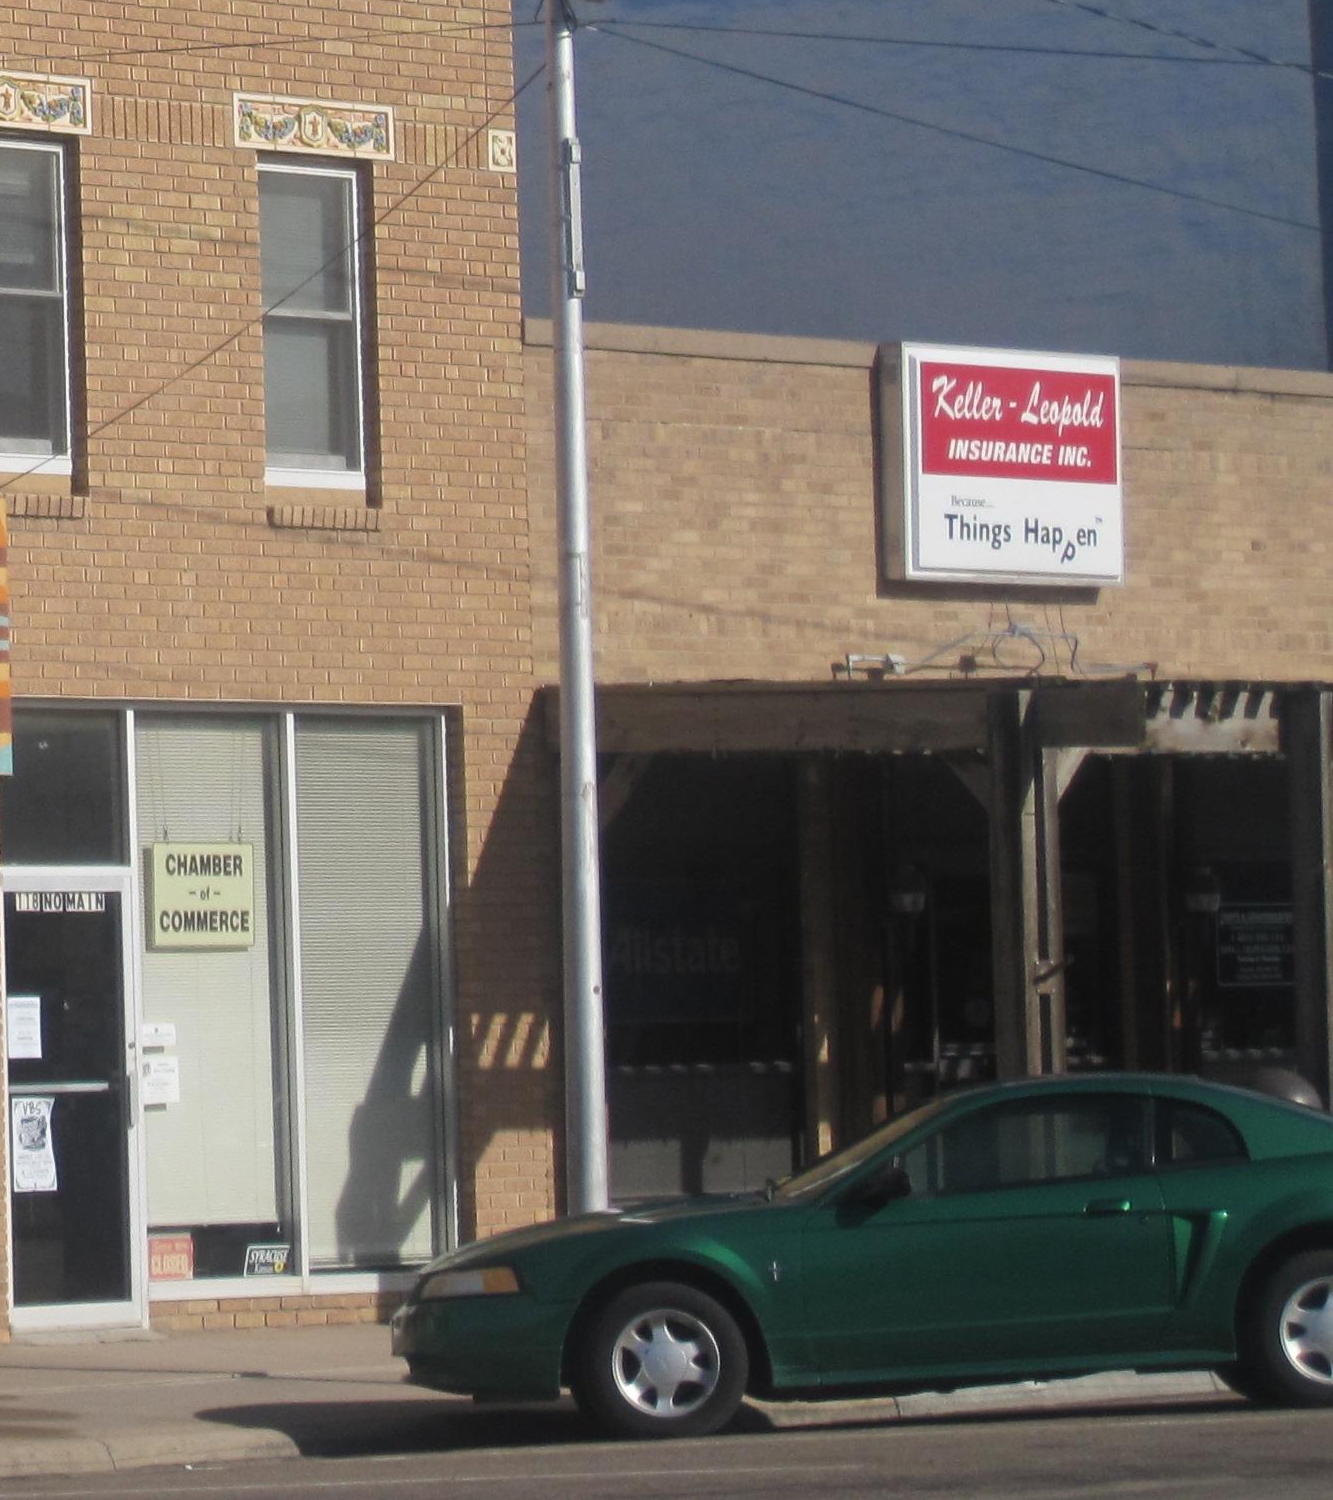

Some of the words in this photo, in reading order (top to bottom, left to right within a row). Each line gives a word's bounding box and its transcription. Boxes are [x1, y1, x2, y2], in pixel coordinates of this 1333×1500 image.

[932, 374, 1003, 421] Keller
[1021, 380, 1104, 437] Leopold
[948, 438, 1053, 465] INSURANCE
[1058, 445, 1092, 468] INC.
[951, 494, 995, 509] Because...
[944, 513, 1012, 550] Things
[1024, 517, 1098, 564] Happen
[165, 853, 243, 877] CHAMBER
[17, 892, 40, 911] 118
[43, 892, 63, 911] NO
[66, 892, 105, 911] MAIN
[199, 886, 210, 901] of
[159, 910, 250, 933] COMMERCE
[609, 927, 741, 976] Allstate
